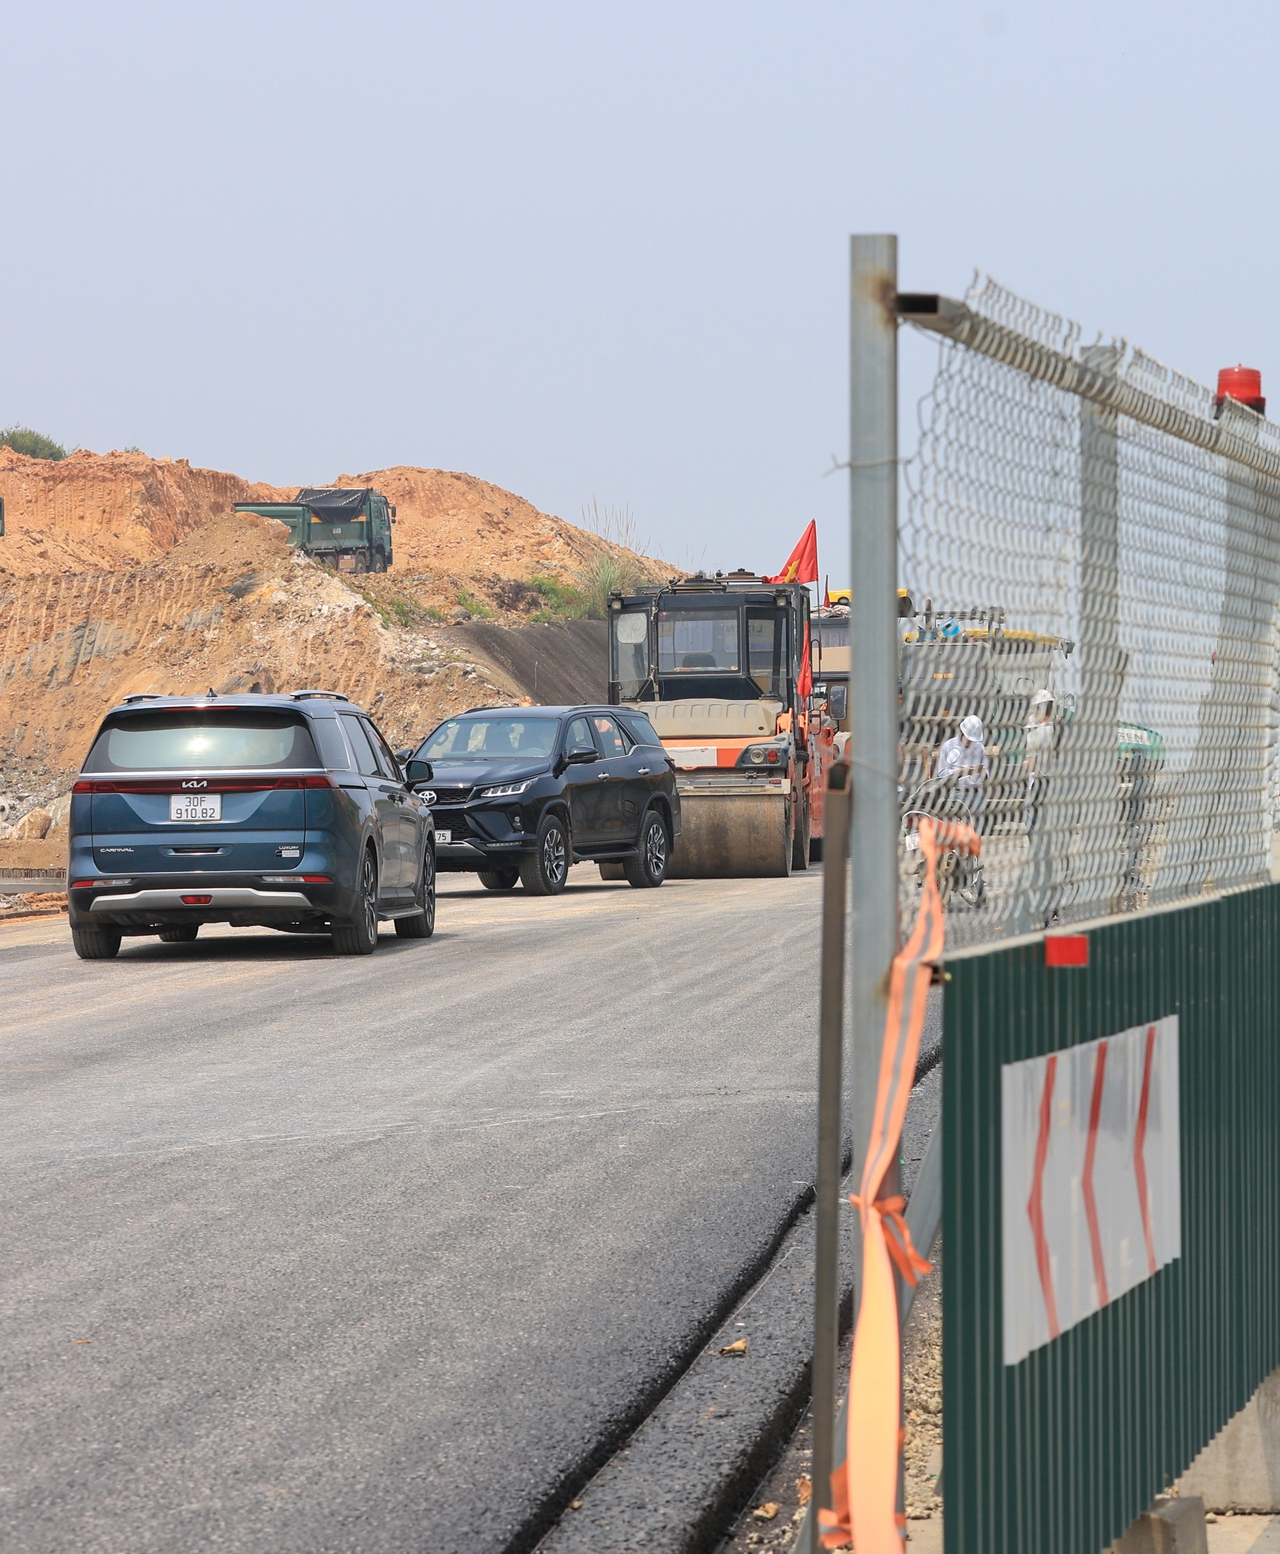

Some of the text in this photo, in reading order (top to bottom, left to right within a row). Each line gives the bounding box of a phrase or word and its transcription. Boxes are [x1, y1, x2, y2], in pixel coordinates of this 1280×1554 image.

[182, 780, 208, 788] KIA
[185, 796, 207, 807] 30F
[175, 807, 216, 819] 910.82
